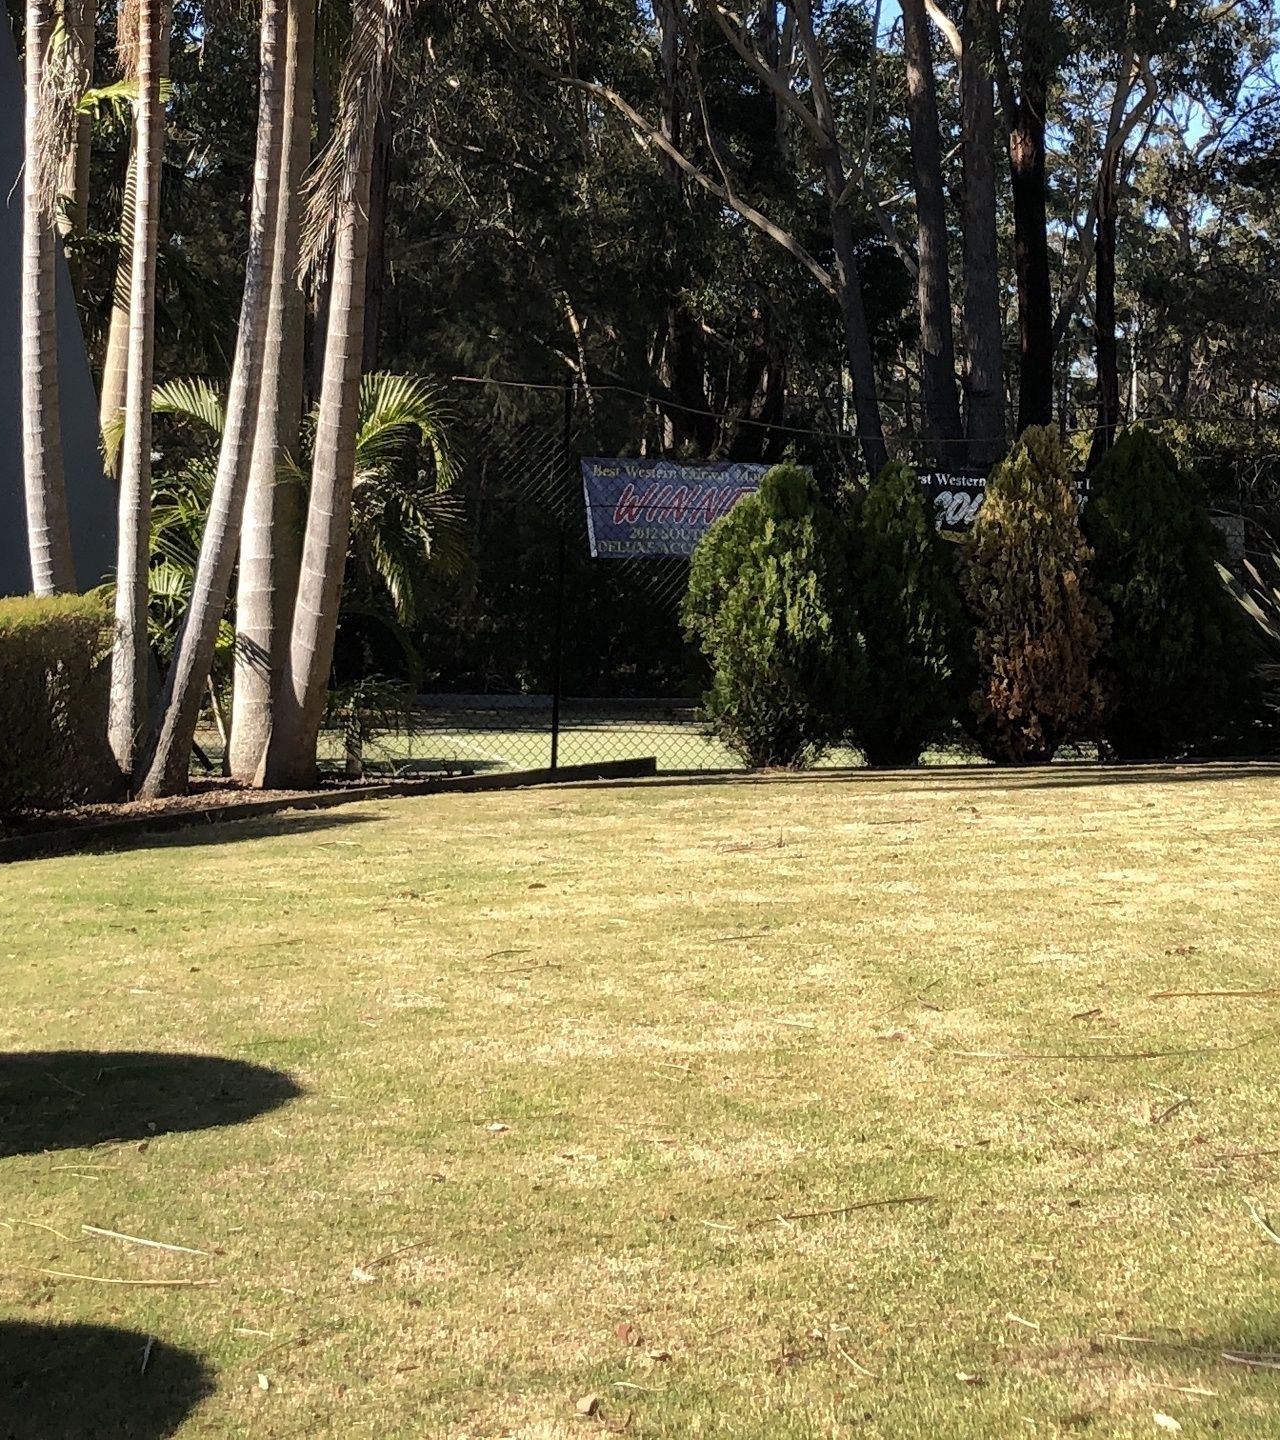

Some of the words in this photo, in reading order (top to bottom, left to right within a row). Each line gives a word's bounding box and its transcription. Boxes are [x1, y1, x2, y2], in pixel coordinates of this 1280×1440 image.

[593, 464, 620, 477] Best
[625, 465, 678, 479] Western
[934, 473, 987, 487] Western
